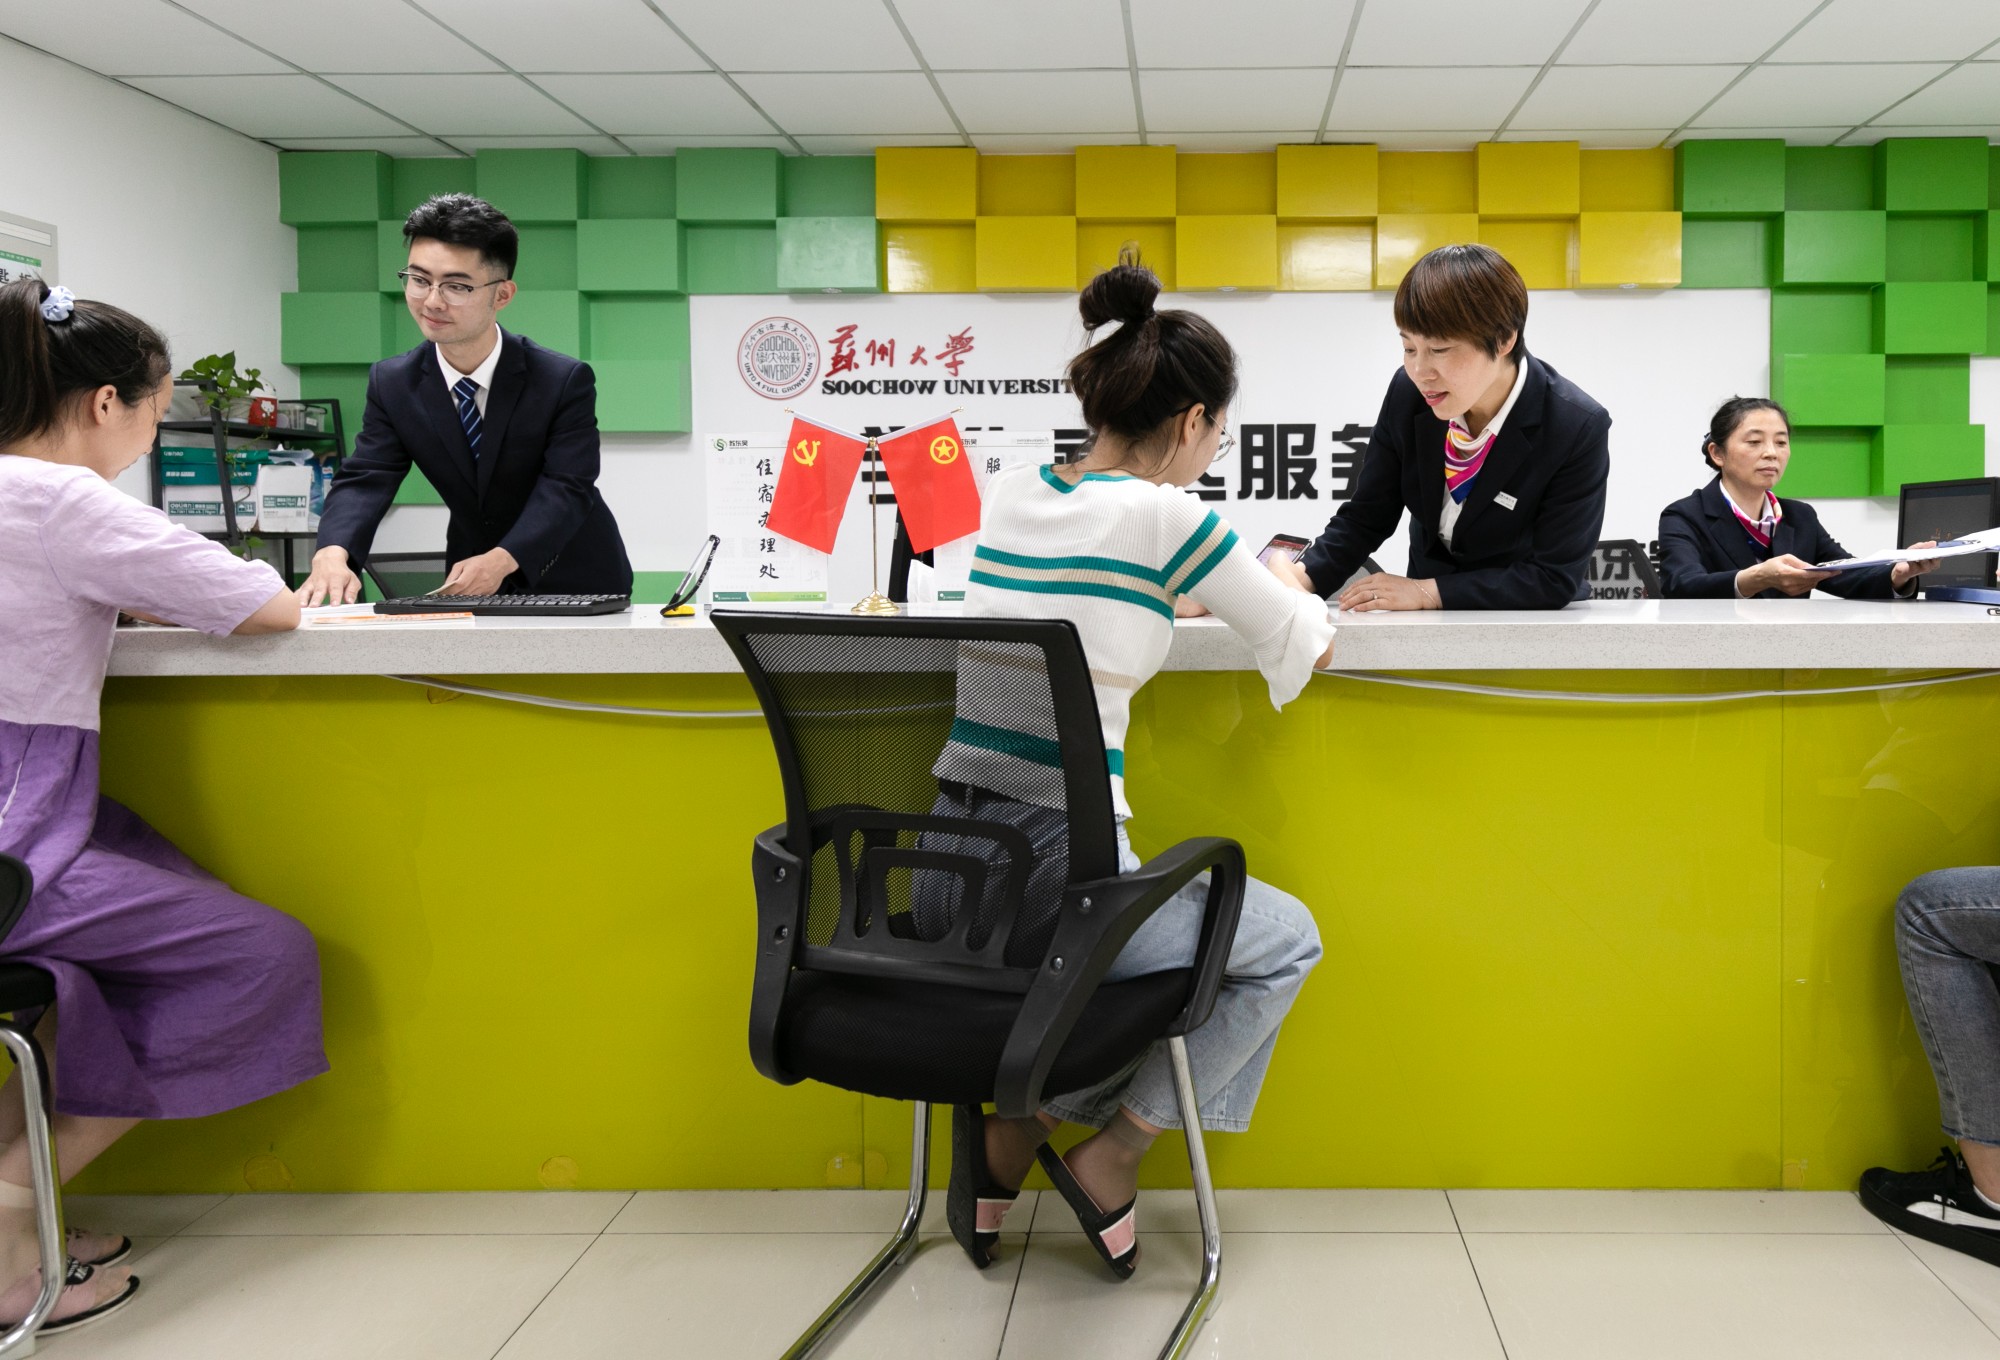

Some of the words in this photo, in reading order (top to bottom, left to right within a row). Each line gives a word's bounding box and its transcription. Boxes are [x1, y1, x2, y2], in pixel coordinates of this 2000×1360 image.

[744, 362, 757, 382] UNTO
[761, 384, 779, 394] FULL
[781, 378, 806, 394] GROWN
[805, 362, 813, 378] MAN
[757, 364, 800, 381] UNIVERSITY
[822, 379, 938, 395] SOOCHOW
[943, 378, 1073, 394] UNIVERSIT
